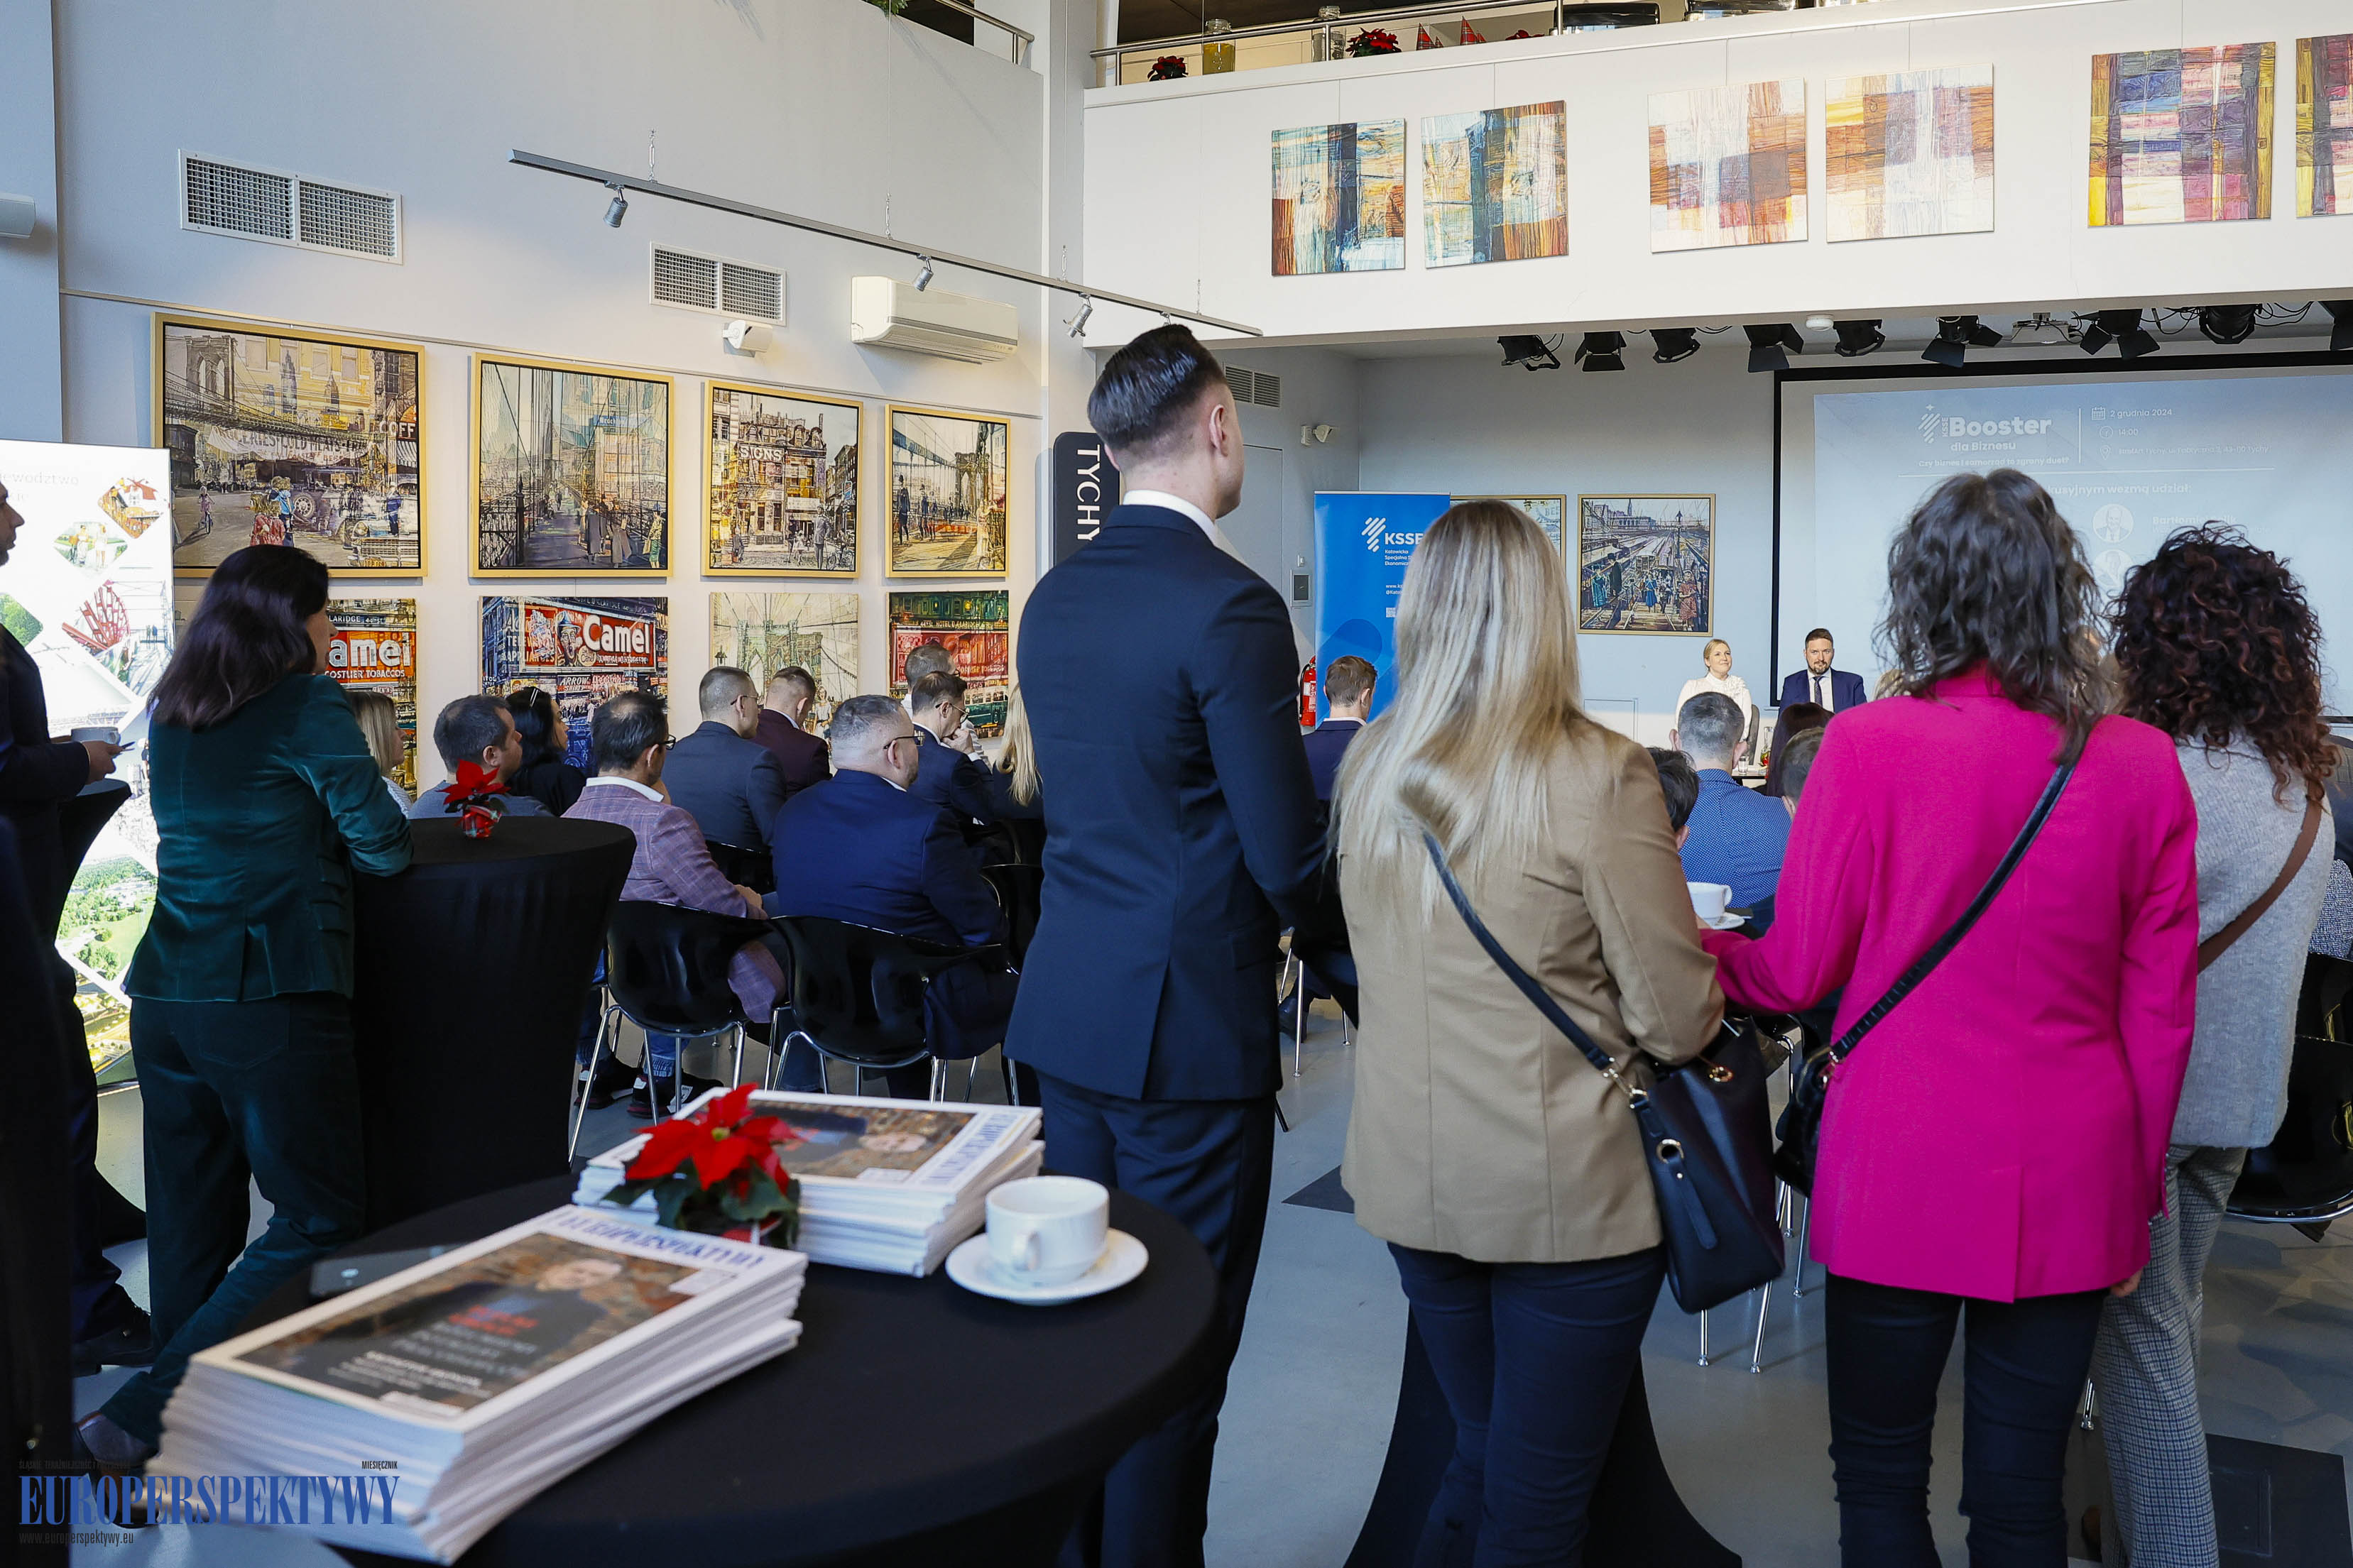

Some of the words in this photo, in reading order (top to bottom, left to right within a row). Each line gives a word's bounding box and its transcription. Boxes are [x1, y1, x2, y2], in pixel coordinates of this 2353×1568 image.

[2117, 410, 2150, 419] grudnia
[1949, 416, 2052, 437] Booster
[1950, 442, 1970, 452] dla
[1971, 441, 2017, 451] Biznesu
[739, 446, 782, 461] SIGNS
[1076, 444, 1101, 542] TYCHY
[2107, 486, 2149, 496] wezmą
[583, 614, 650, 654] Camel
[324, 670, 364, 679] COSTLIER
[365, 669, 405, 678] TOBACCOS
[559, 676, 589, 686] ARROW
